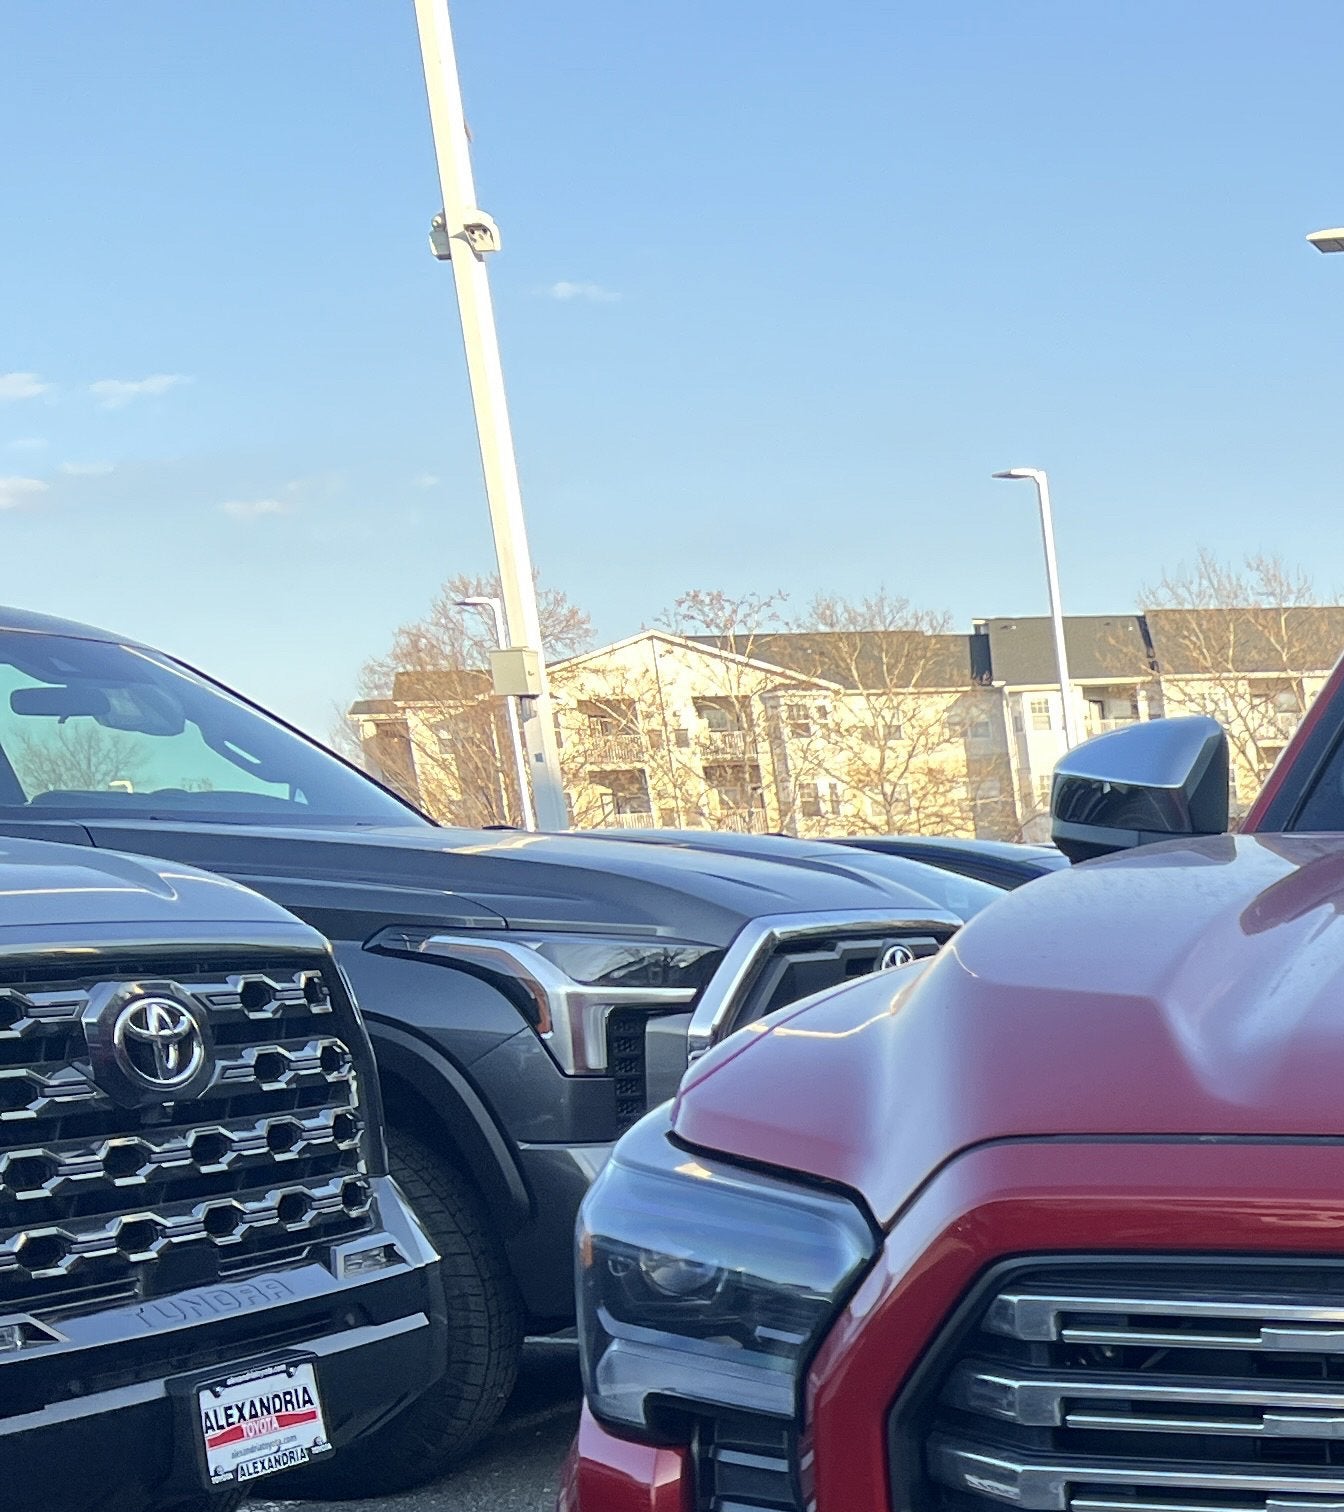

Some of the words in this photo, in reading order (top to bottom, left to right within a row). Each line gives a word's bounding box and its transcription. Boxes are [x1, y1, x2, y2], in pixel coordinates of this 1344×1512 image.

[124, 1279, 295, 1328] TUNDRA
[204, 1386, 314, 1434] ALEXANDRIA
[243, 1416, 280, 1439] TOYOTA
[239, 1448, 308, 1479] ALEXANDRIA
